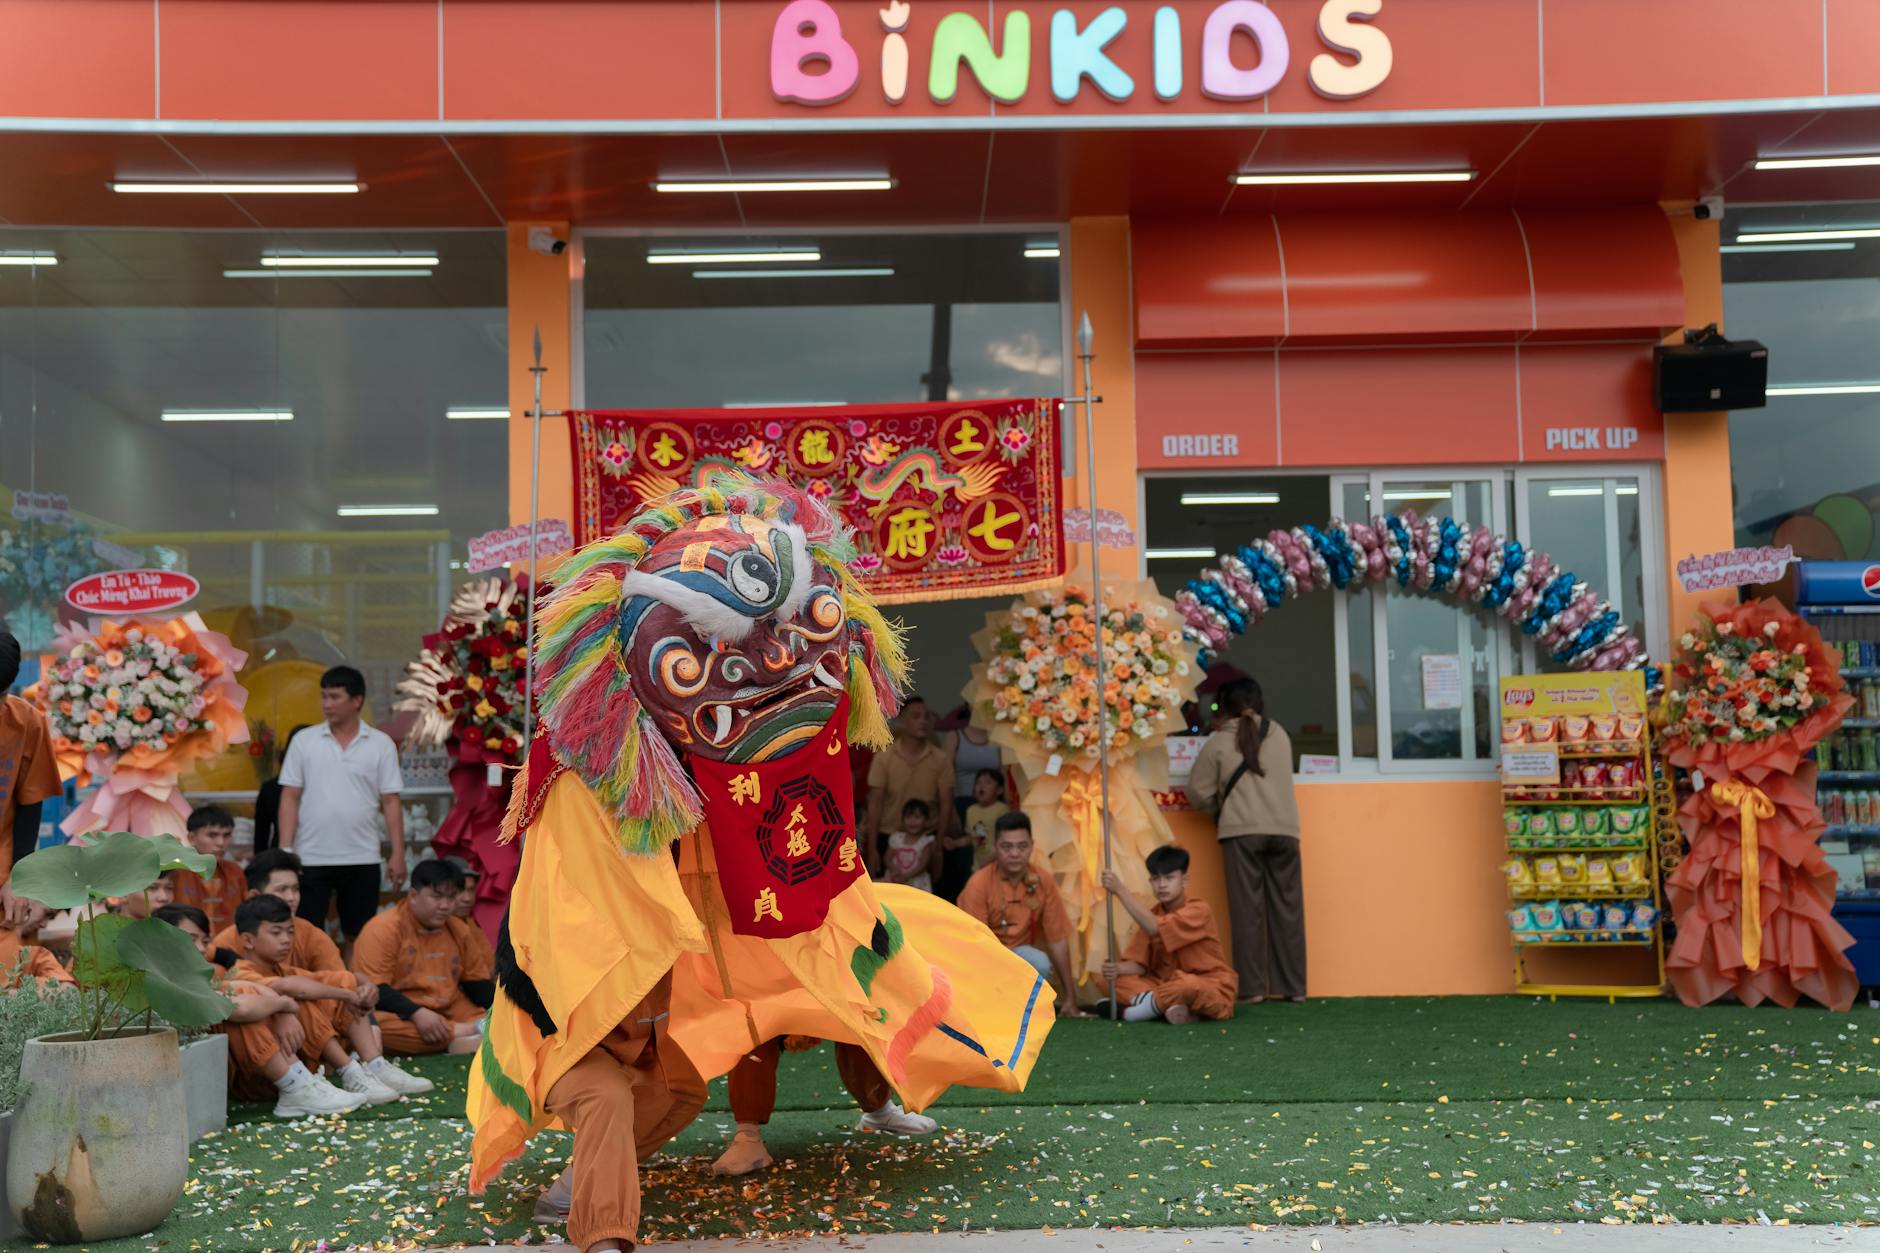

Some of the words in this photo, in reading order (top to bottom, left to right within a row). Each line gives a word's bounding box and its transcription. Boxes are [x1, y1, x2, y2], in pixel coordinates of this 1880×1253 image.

[949, 418, 985, 455] 土
[1162, 433, 1238, 457] ORDER
[1546, 427, 1600, 450] PICK
[1605, 426, 1638, 449] UP
[884, 507, 935, 559] 府
[967, 500, 1021, 550] 七
[728, 771, 761, 806] 利
